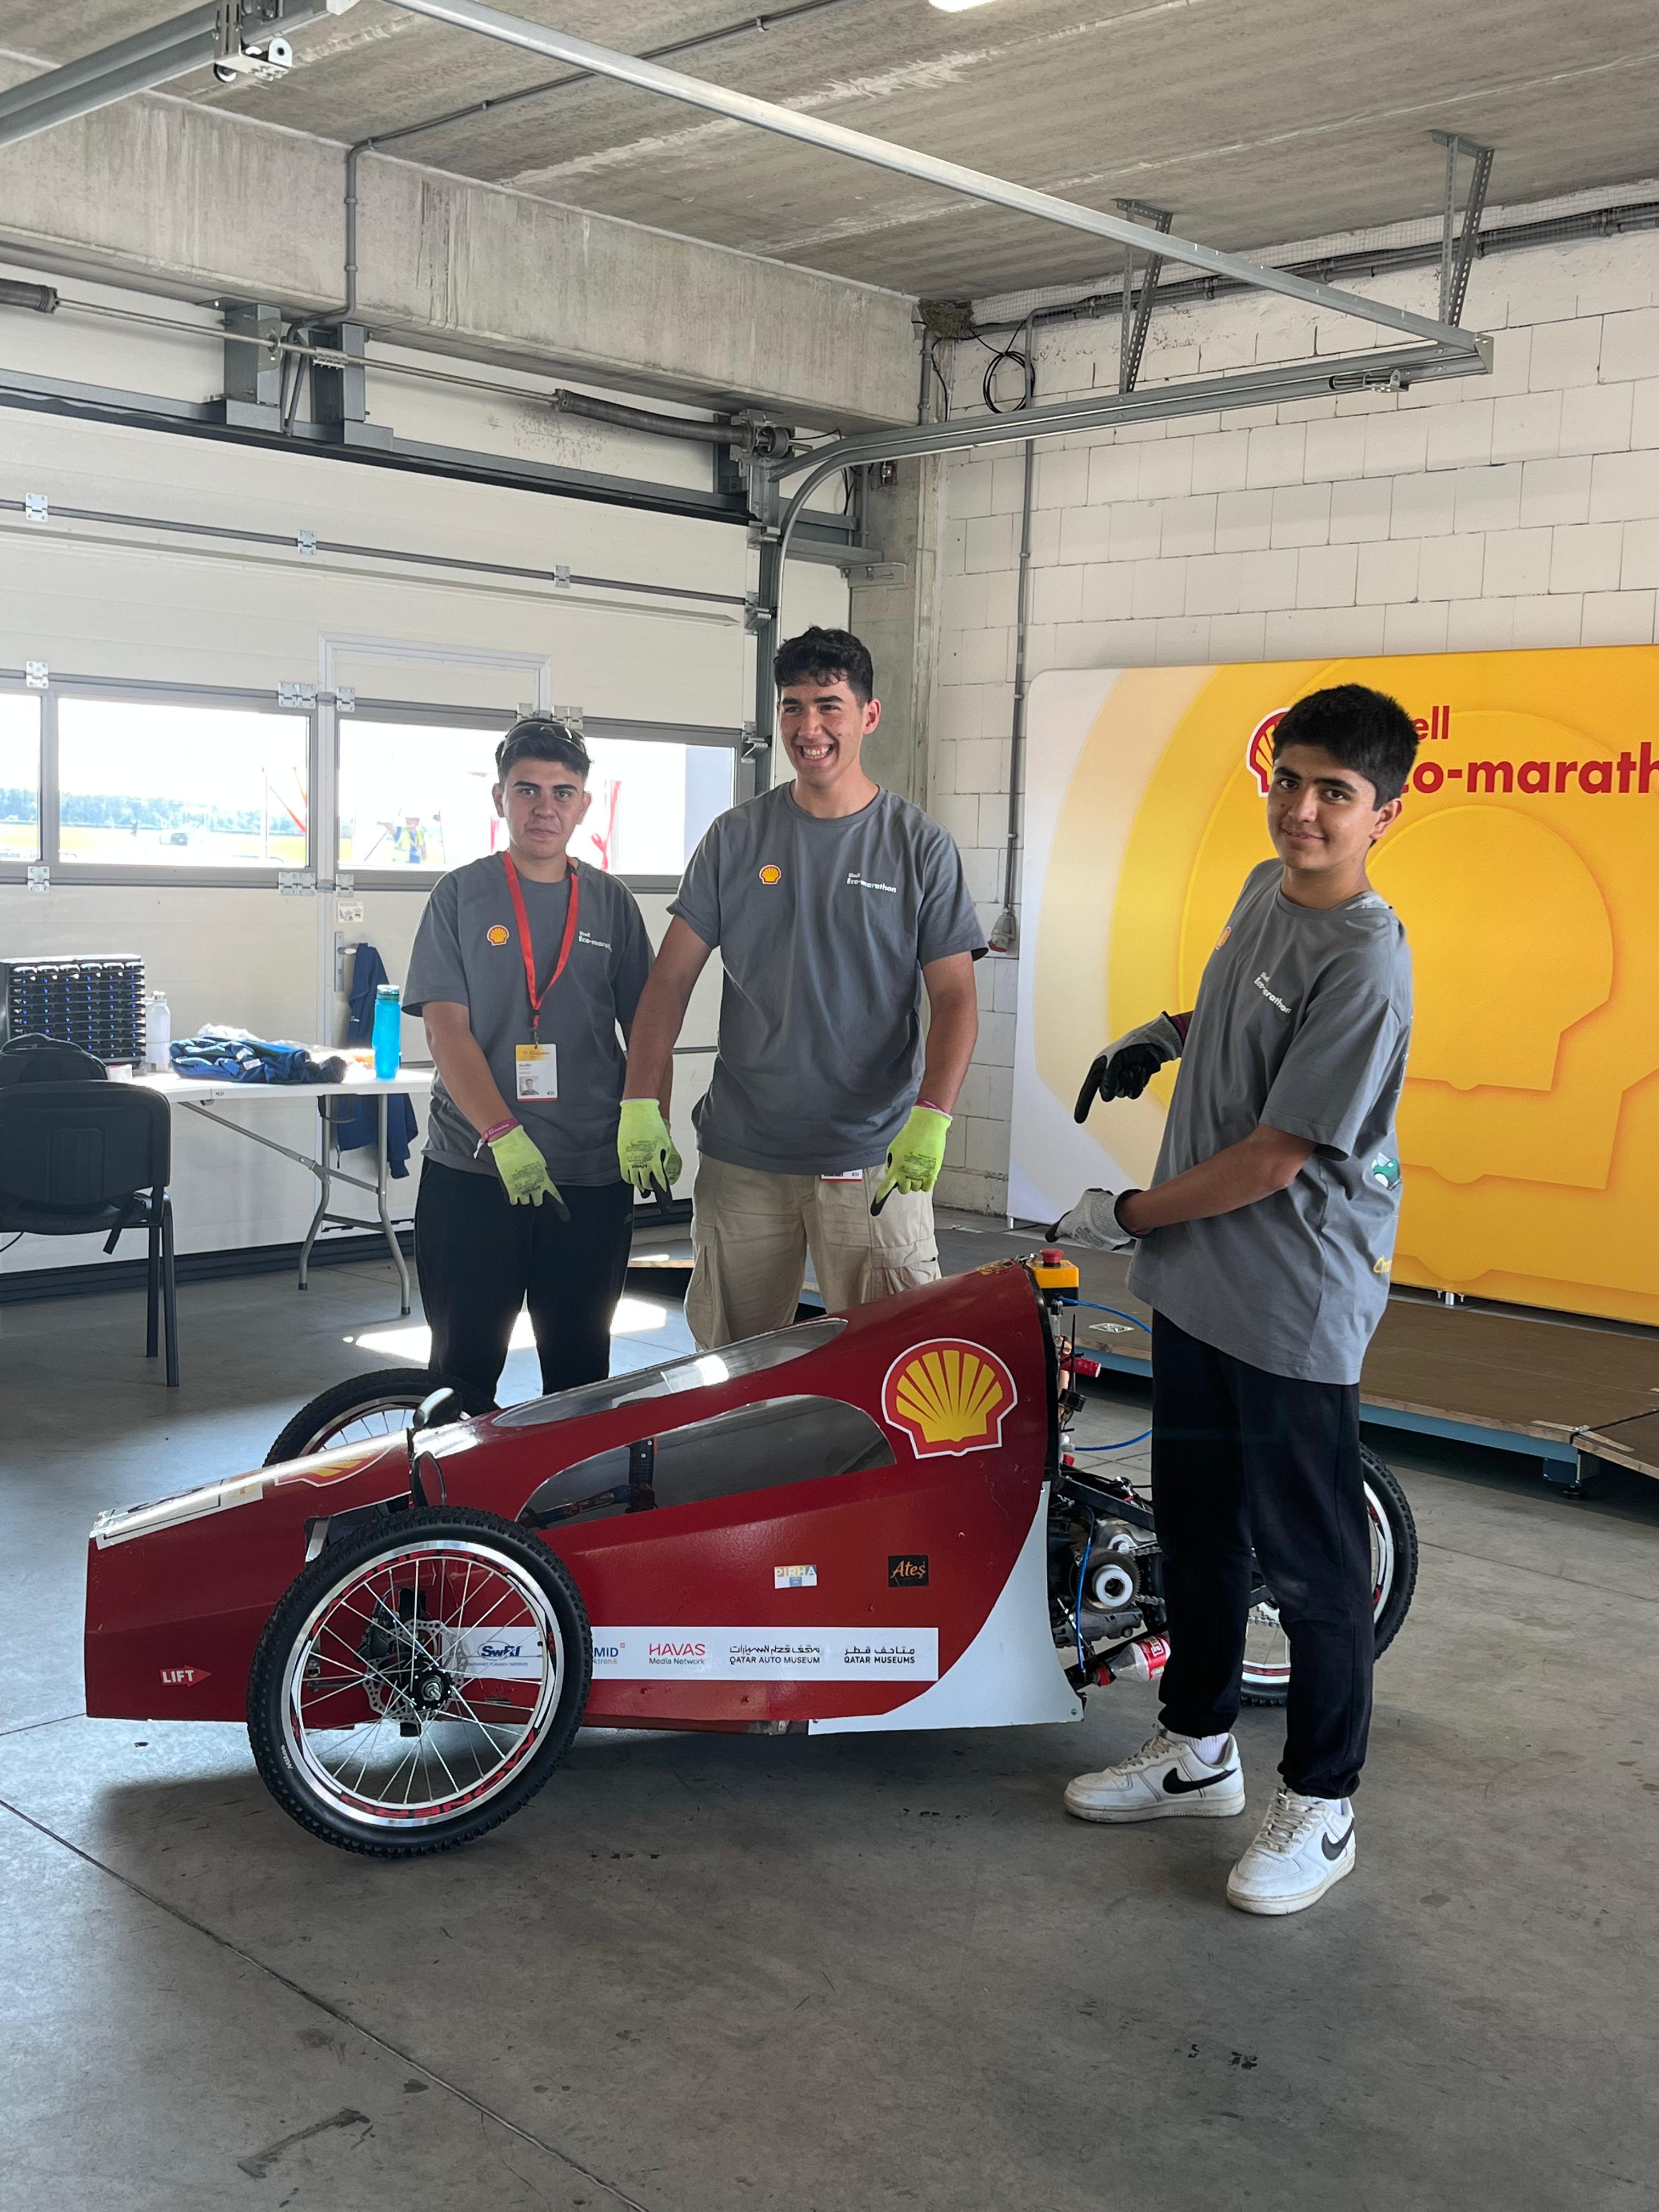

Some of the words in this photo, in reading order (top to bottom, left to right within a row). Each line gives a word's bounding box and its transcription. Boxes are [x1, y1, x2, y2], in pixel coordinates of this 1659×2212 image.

[1414, 705, 1451, 740] ell
[1403, 742, 1659, 794] o-marath
[847, 877, 897, 893] Eco-marathon
[889, 1560, 926, 1579] Ateş
[594, 1647, 619, 1657] MID
[649, 1643, 706, 1656] HAVAS
[729, 1656, 757, 1665] QATAR
[758, 1656, 782, 1664] AUTO
[783, 1656, 820, 1664] MUSEUM
[844, 1656, 871, 1664] QATAR
[874, 1656, 915, 1664] MUSEUMS
[161, 1670, 195, 1684] LIFT
